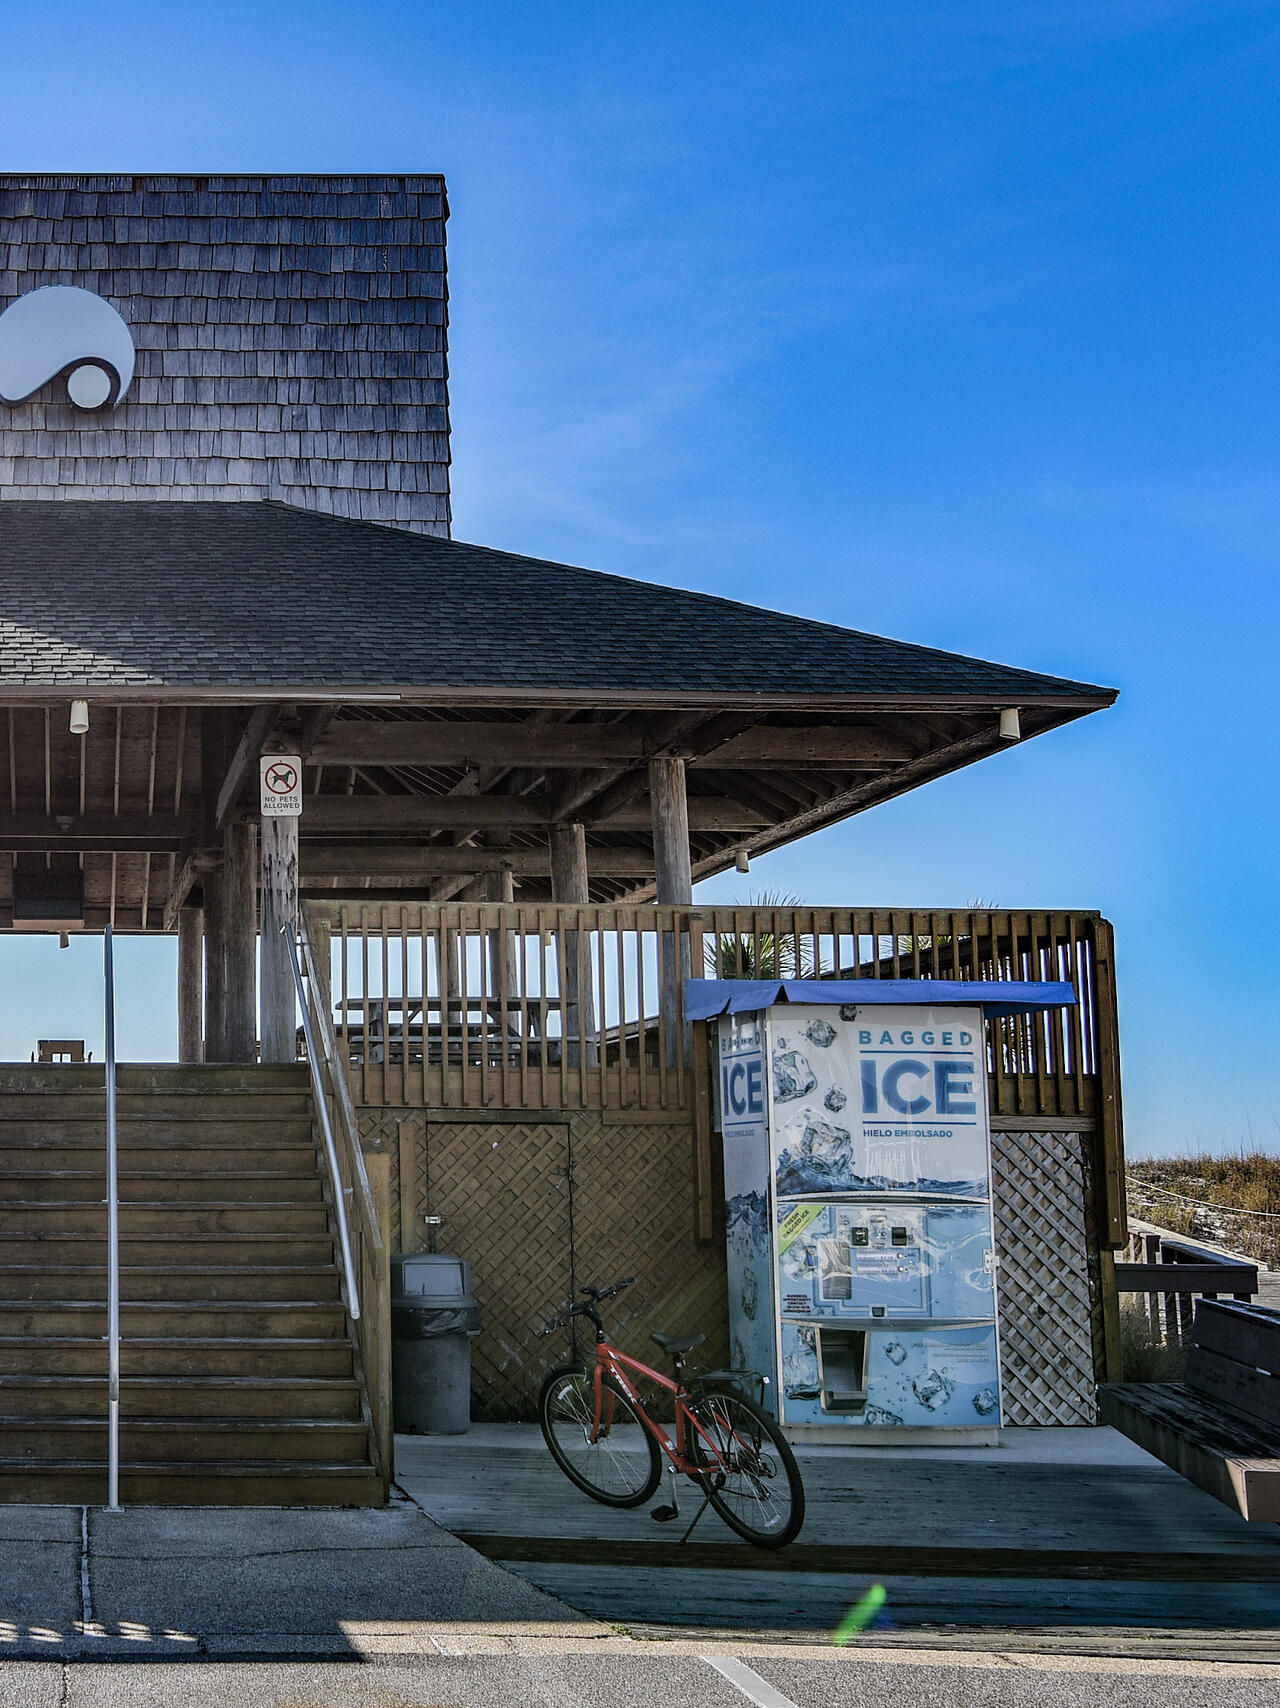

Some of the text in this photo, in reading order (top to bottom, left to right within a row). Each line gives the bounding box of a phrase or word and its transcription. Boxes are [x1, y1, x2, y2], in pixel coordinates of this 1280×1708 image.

[721, 1031, 760, 1051] BAGD
[858, 1030, 973, 1046] BAGGED
[723, 1060, 763, 1116] ICE
[860, 1058, 977, 1116] ICE
[863, 1129, 953, 1138] HIELO EMBOLSADO
[782, 1209, 810, 1239] BAGGED ICE
[784, 1212, 800, 1229] FRESH
